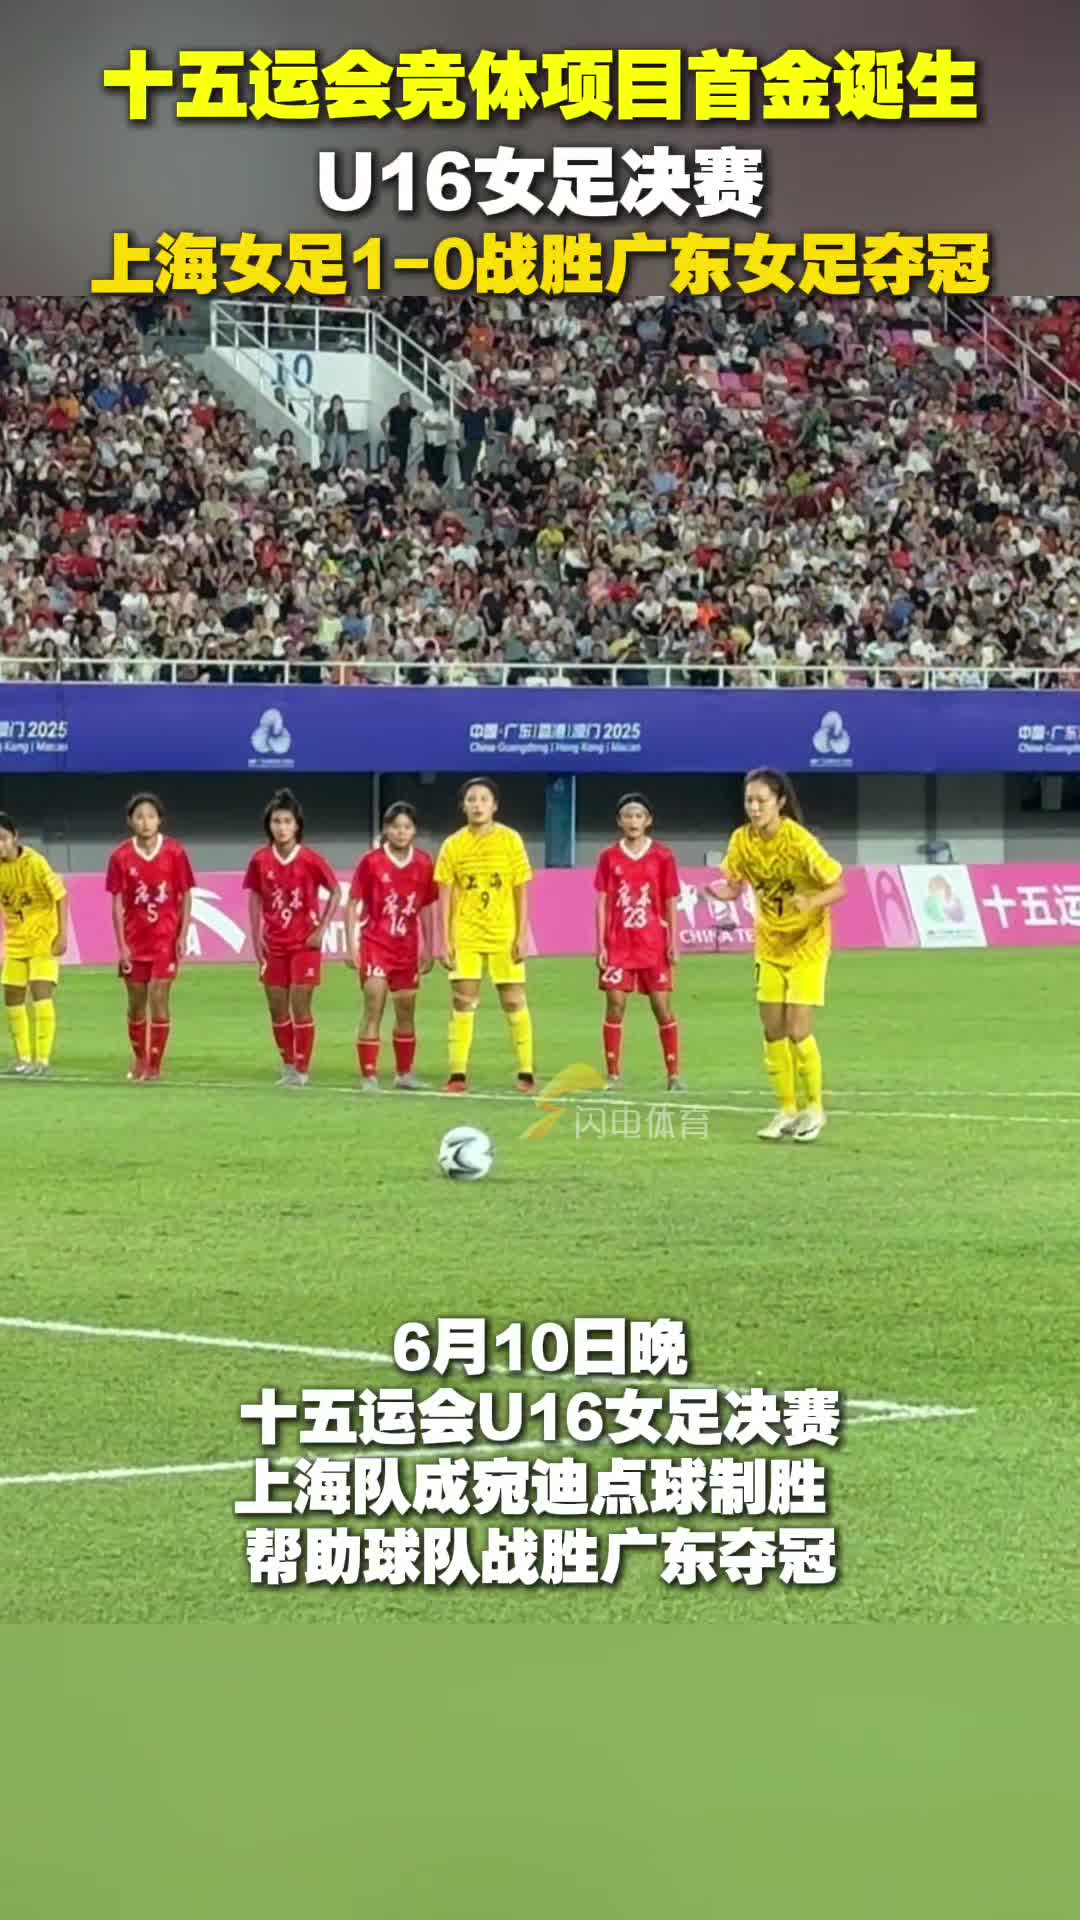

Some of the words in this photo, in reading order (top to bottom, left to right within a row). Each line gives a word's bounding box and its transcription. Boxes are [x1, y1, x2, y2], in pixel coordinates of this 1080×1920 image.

[271, 352, 314, 387] 10
[27, 720, 68, 738] 2025
[603, 723, 641, 739] 2025
[481, 891, 491, 909] 9
[147, 903, 159, 923] 5
[281, 908, 293, 928] 9
[623, 906, 648, 929] 23
